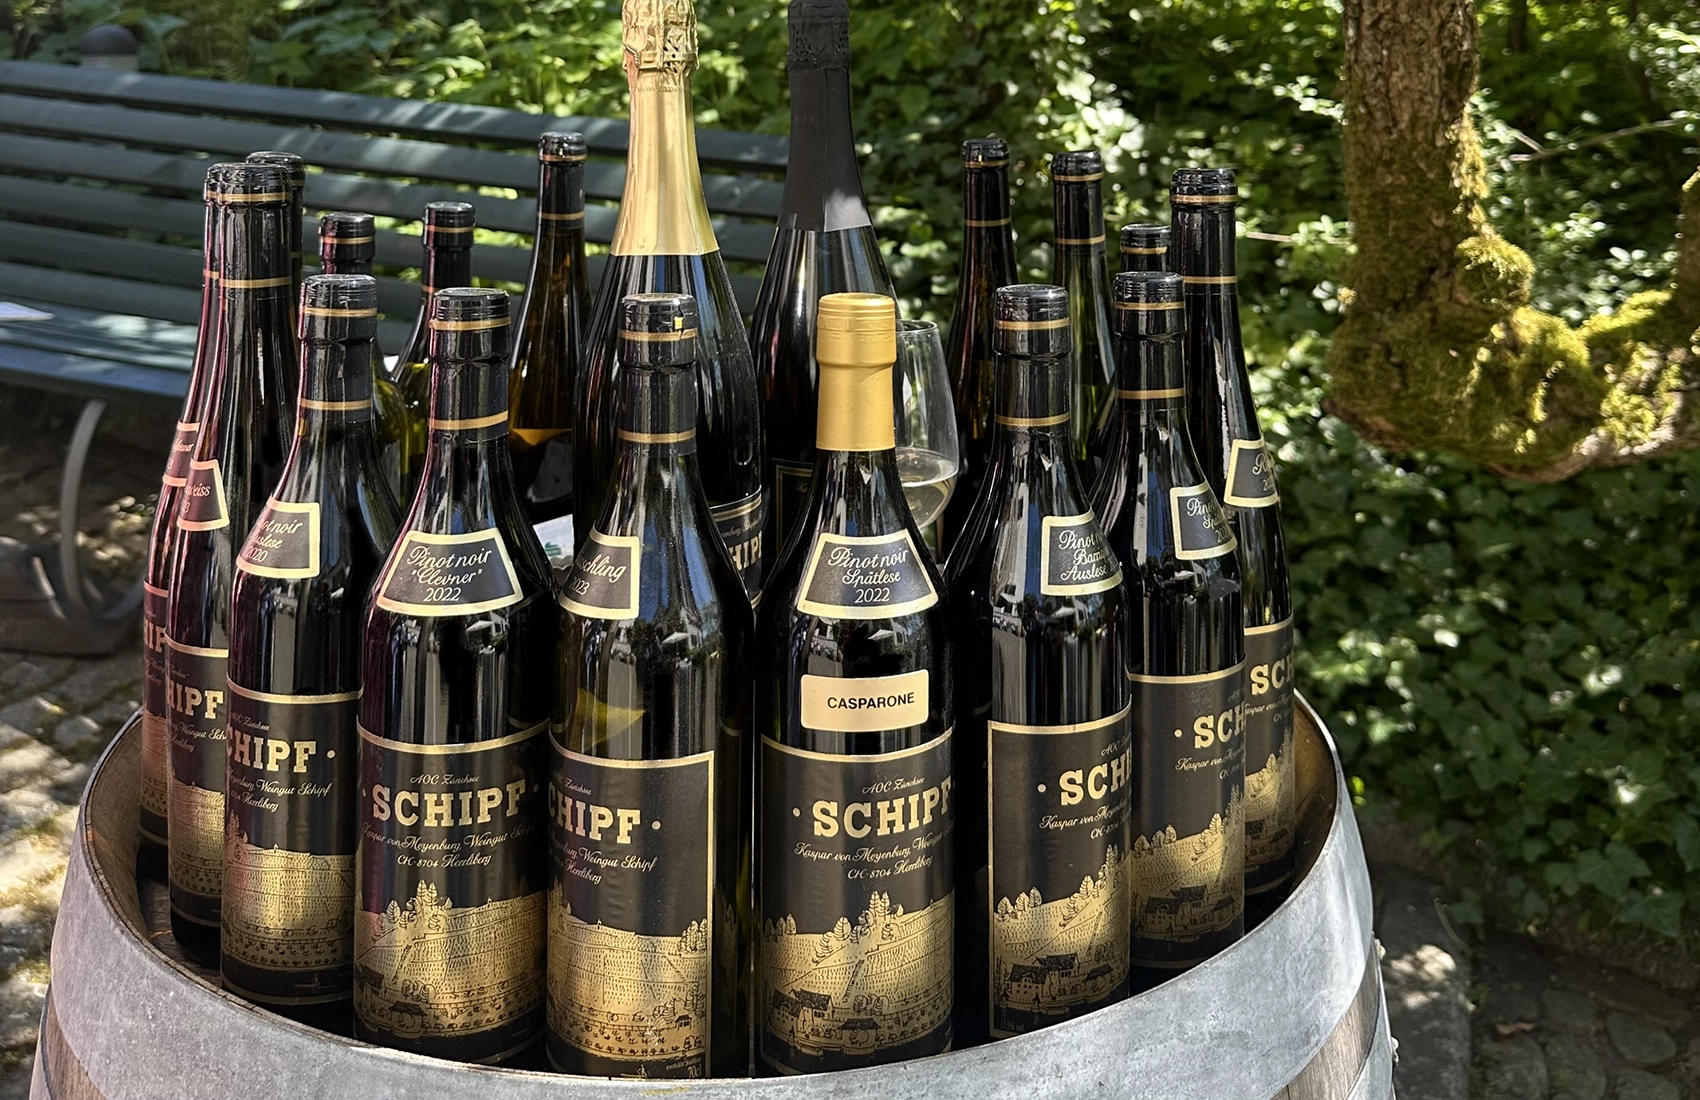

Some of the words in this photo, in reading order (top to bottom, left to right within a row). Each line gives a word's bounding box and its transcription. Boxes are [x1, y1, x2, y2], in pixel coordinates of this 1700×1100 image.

[273, 519, 303, 534] noir
[1058, 530, 1095, 549] Pinot
[407, 546, 455, 569] Pinot
[455, 548, 492, 568] noir
[828, 547, 879, 568] Pinot
[880, 548, 909, 567] noir
[842, 569, 901, 587] Spätlese
[1060, 563, 1107, 580] Auslese
[423, 587, 461, 602] 2022
[569, 577, 590, 595] 2023
[855, 588, 890, 603] 2022
[827, 692, 915, 709] CASPARONE
[1175, 757, 1208, 771] Kaspar
[256, 779, 296, 797] Weingut
[298, 782, 333, 798] Schipf
[410, 774, 439, 785] AOC
[862, 780, 891, 793] AOC
[243, 791, 279, 813] Herrliberg
[372, 778, 526, 827] SCHIPF
[812, 775, 951, 838] SCHIPF
[1039, 814, 1078, 830] Kaspar
[1080, 816, 1094, 825] von
[387, 837, 401, 847] von
[464, 831, 508, 848] Weingut
[794, 842, 832, 861] Kaspar
[832, 853, 851, 862] von
[912, 832, 942, 850] Weingut
[441, 853, 492, 868] Herrliberg
[579, 846, 619, 868] Weingut
[621, 855, 658, 871] Schipf
[893, 855, 933, 875] Herrliberg
[565, 858, 602, 884] Herrliberg
